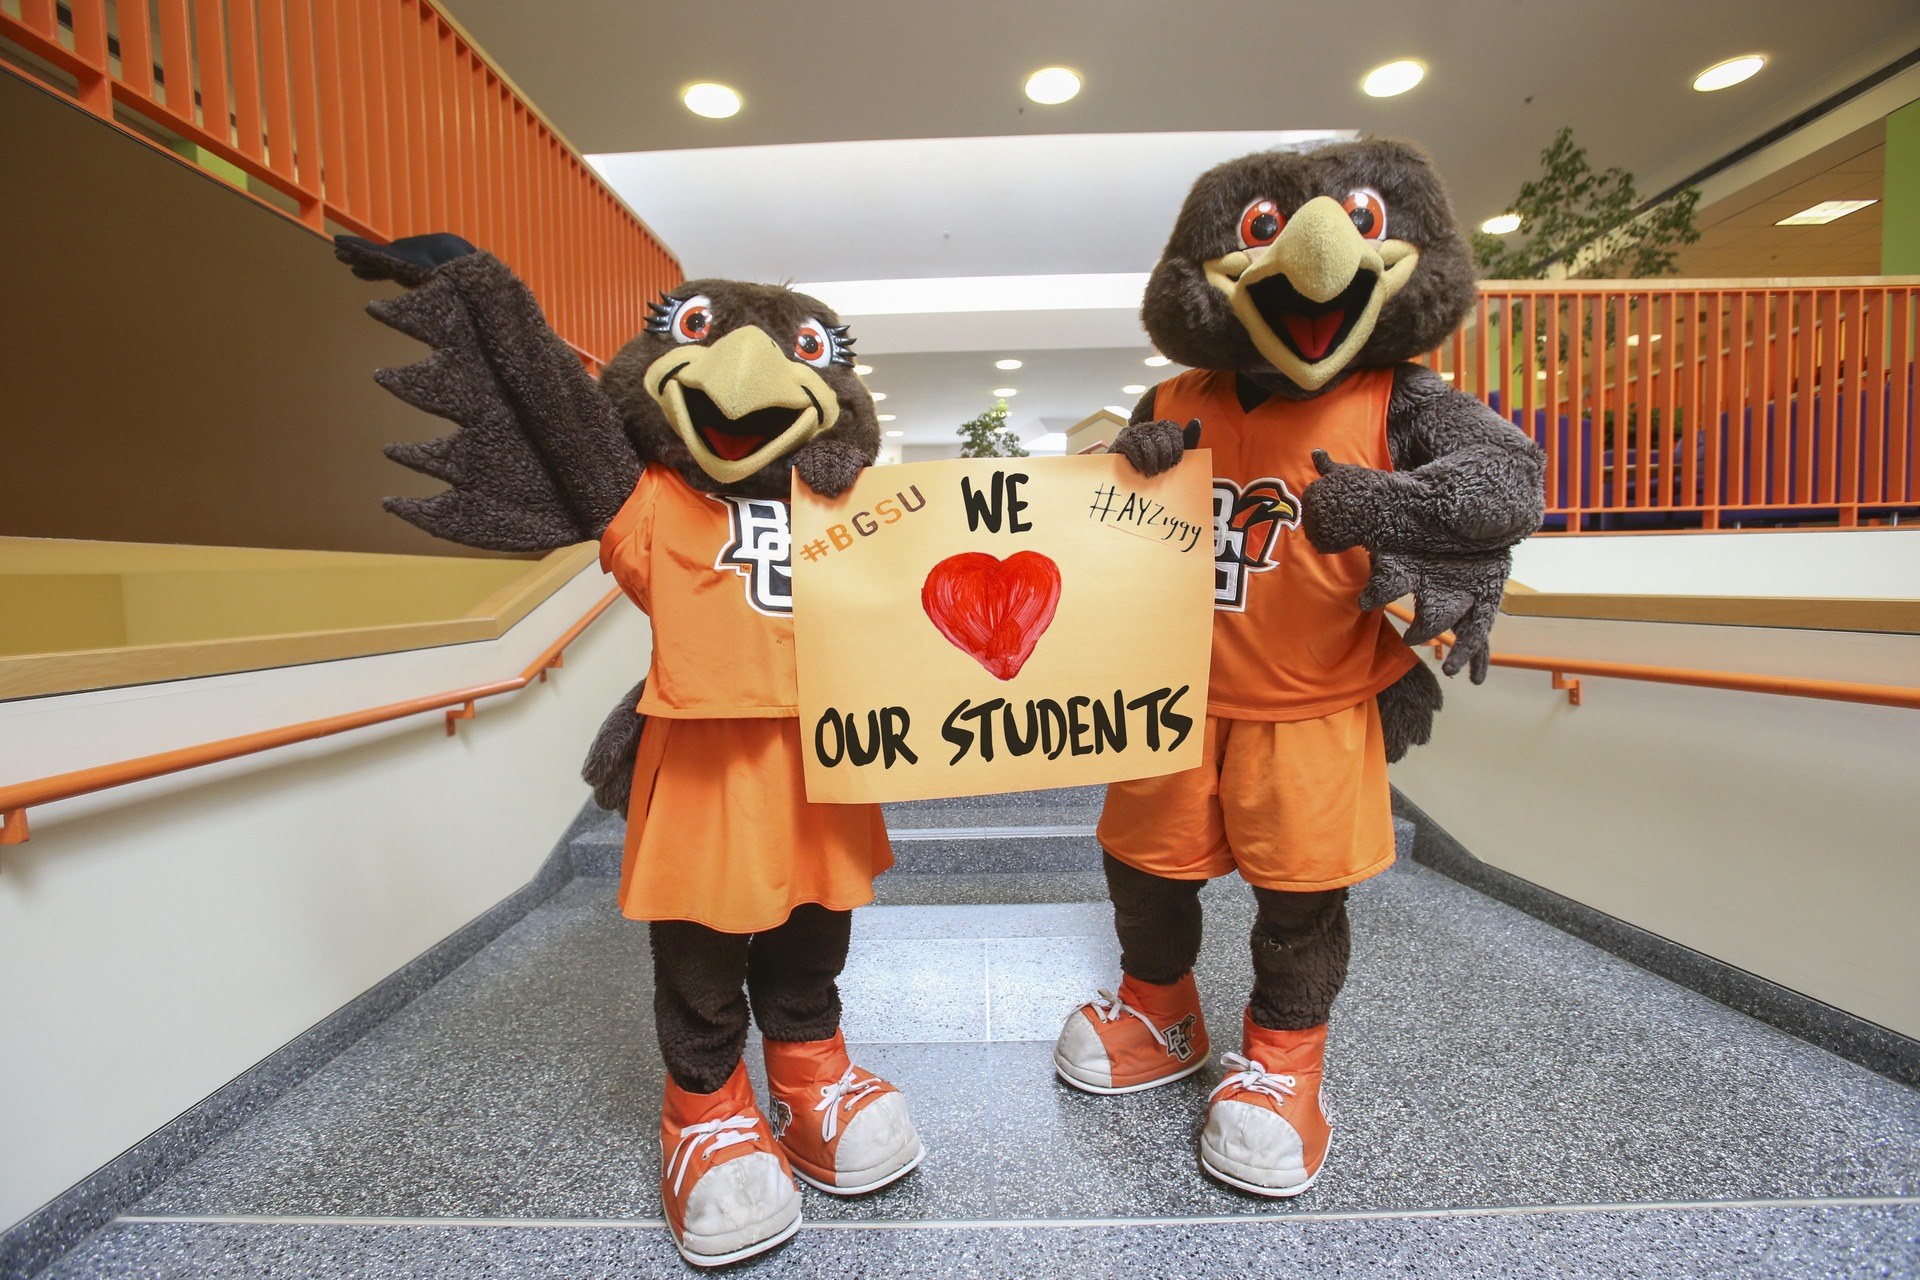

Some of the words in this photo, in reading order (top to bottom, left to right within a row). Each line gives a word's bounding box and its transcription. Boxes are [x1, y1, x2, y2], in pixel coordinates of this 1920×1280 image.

[800, 485, 926, 562] #BGSU
[961, 471, 1032, 533] WE
[1089, 483, 1201, 552] #AYZiggy
[815, 707, 918, 769] OUR
[942, 685, 1193, 766] STUDENTS
